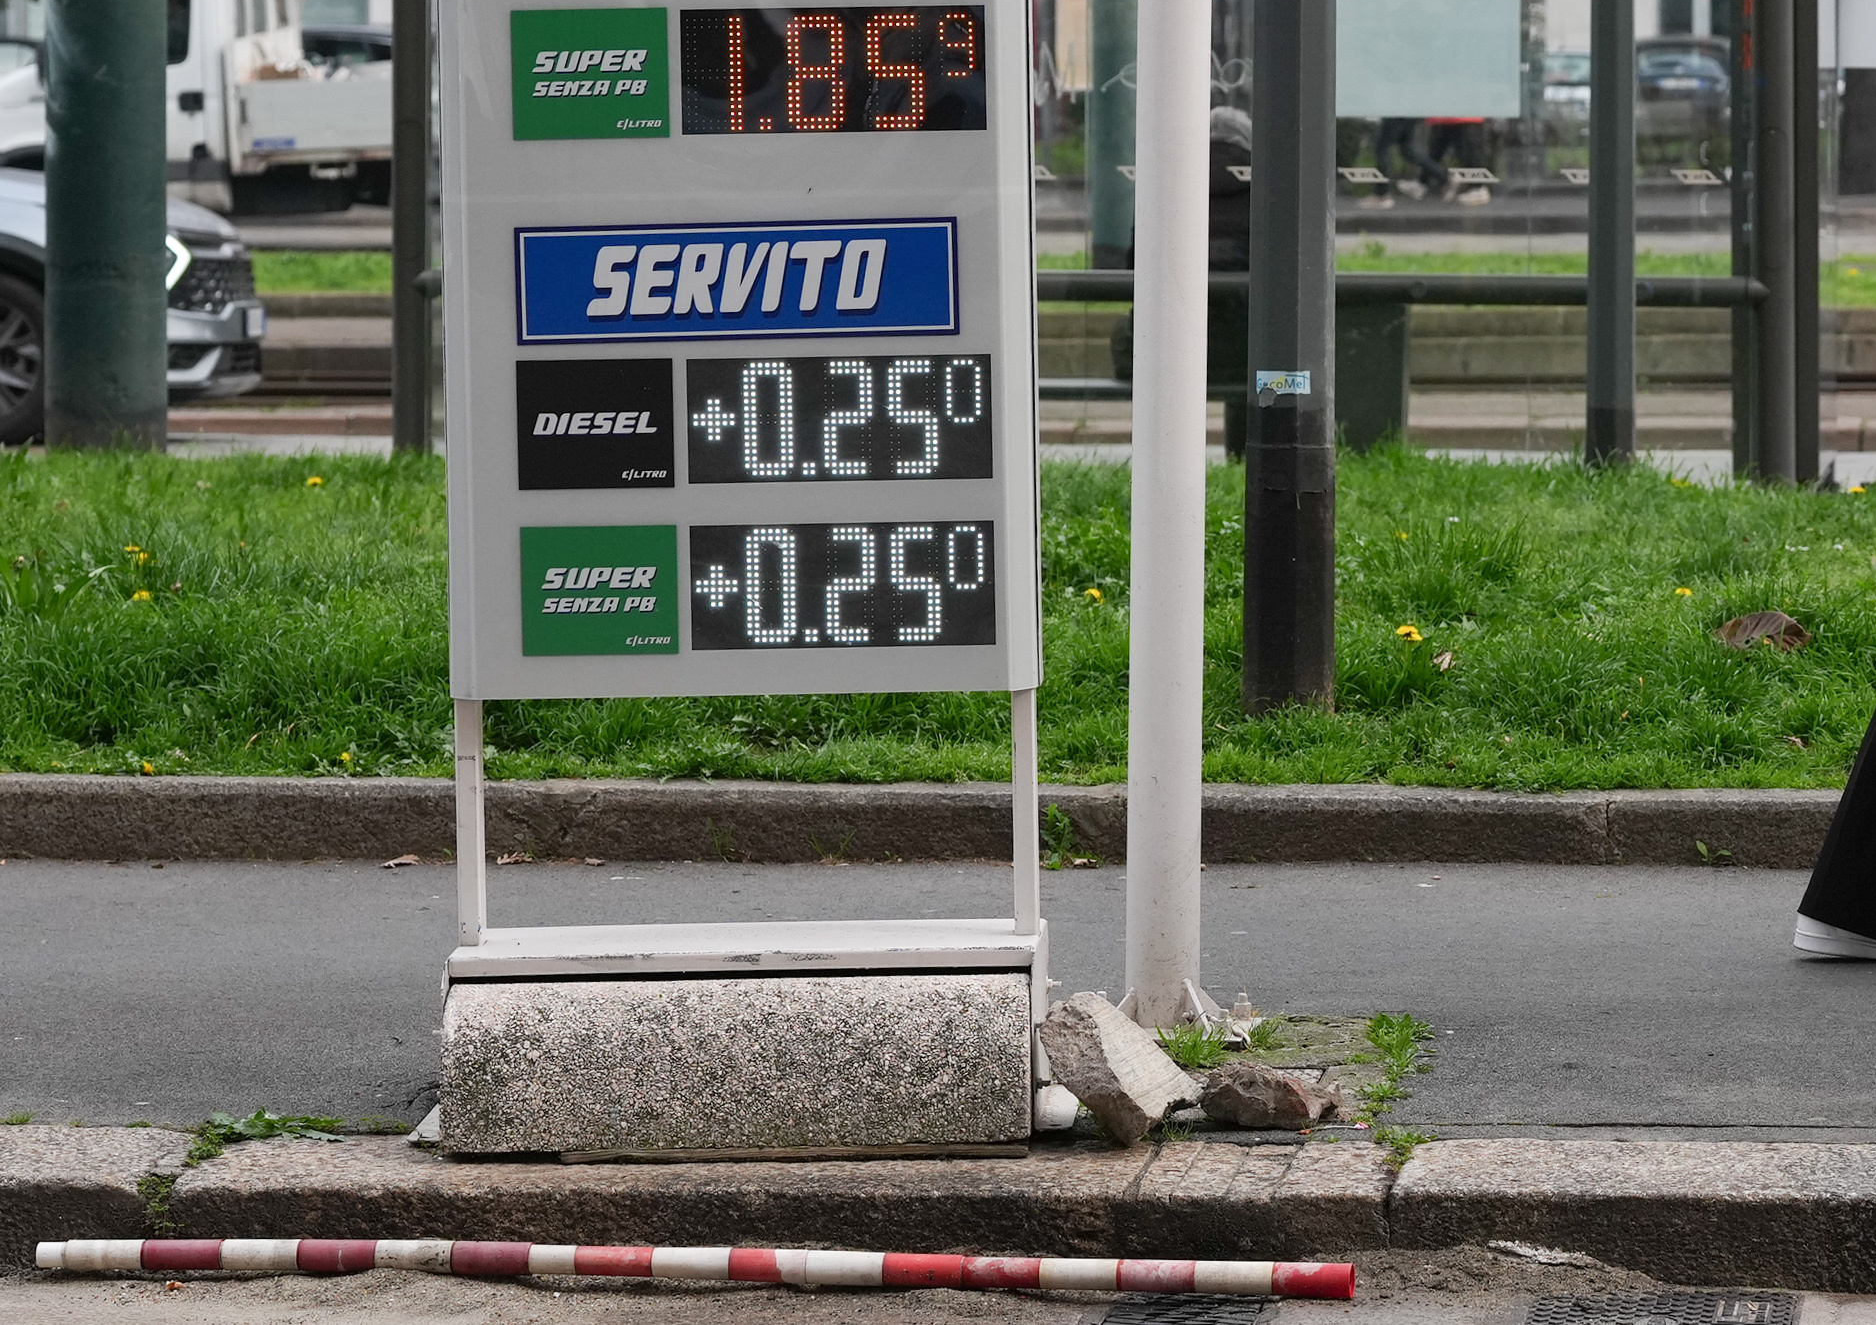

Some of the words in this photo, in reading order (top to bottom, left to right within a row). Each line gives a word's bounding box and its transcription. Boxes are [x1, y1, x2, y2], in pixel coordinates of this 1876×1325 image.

[532, 49, 648, 72] SUPER
[532, 81, 611, 98] SENZA
[614, 79, 646, 96] PB
[585, 238, 888, 319] SERVITO
[532, 411, 658, 436] DIESEL
[541, 566, 657, 589] SUPER
[541, 596, 618, 614] SENZA
[623, 596, 656, 614] PB
